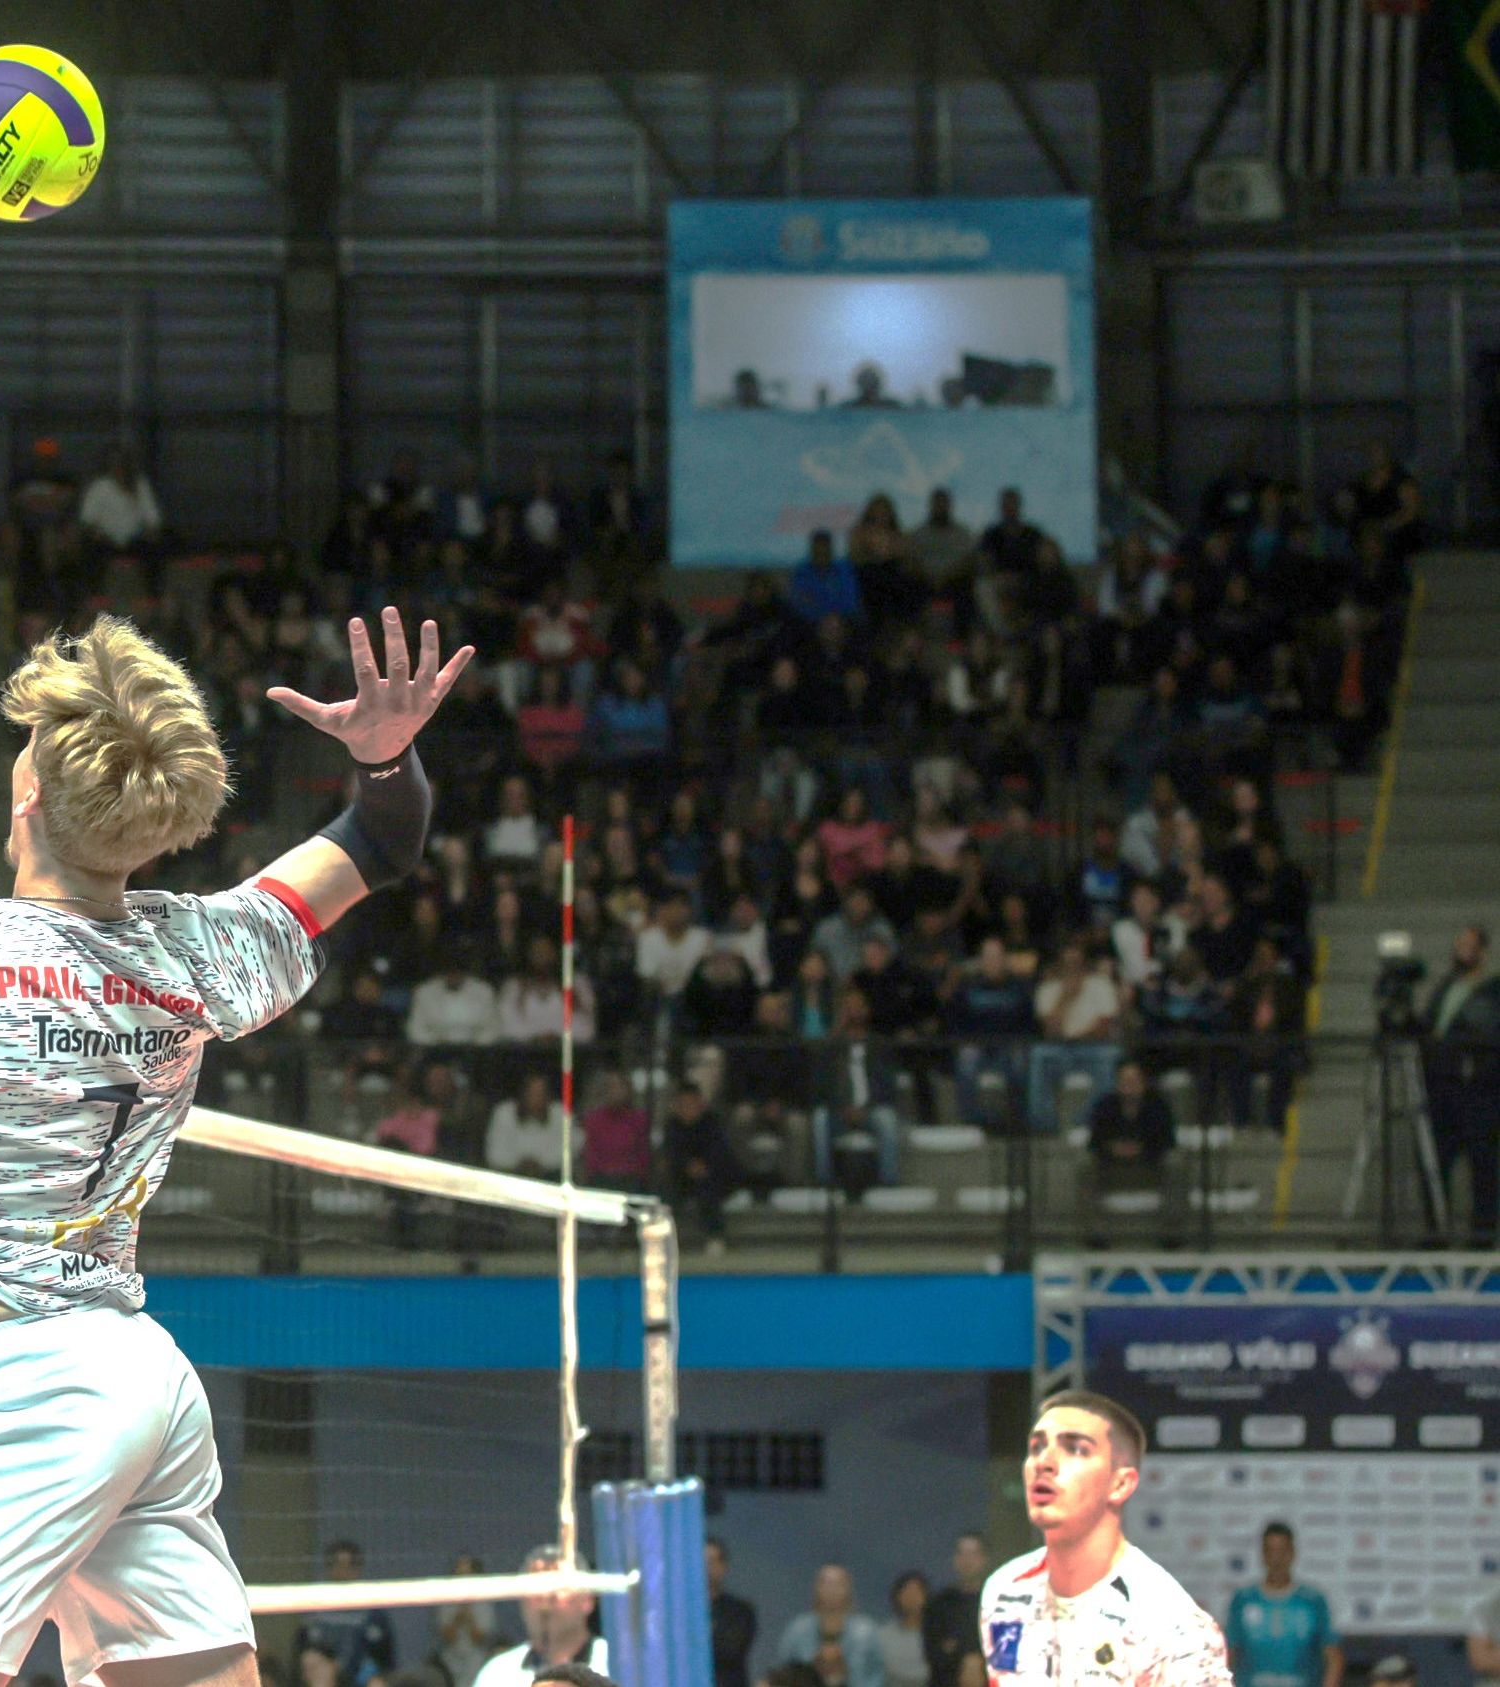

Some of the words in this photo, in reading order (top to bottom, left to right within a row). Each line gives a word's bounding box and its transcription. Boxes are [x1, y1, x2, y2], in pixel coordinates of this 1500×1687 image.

[32, 1015, 191, 1059] Trasmontano
[142, 1047, 182, 1071] Saúde
[78, 1083, 144, 1200] 7
